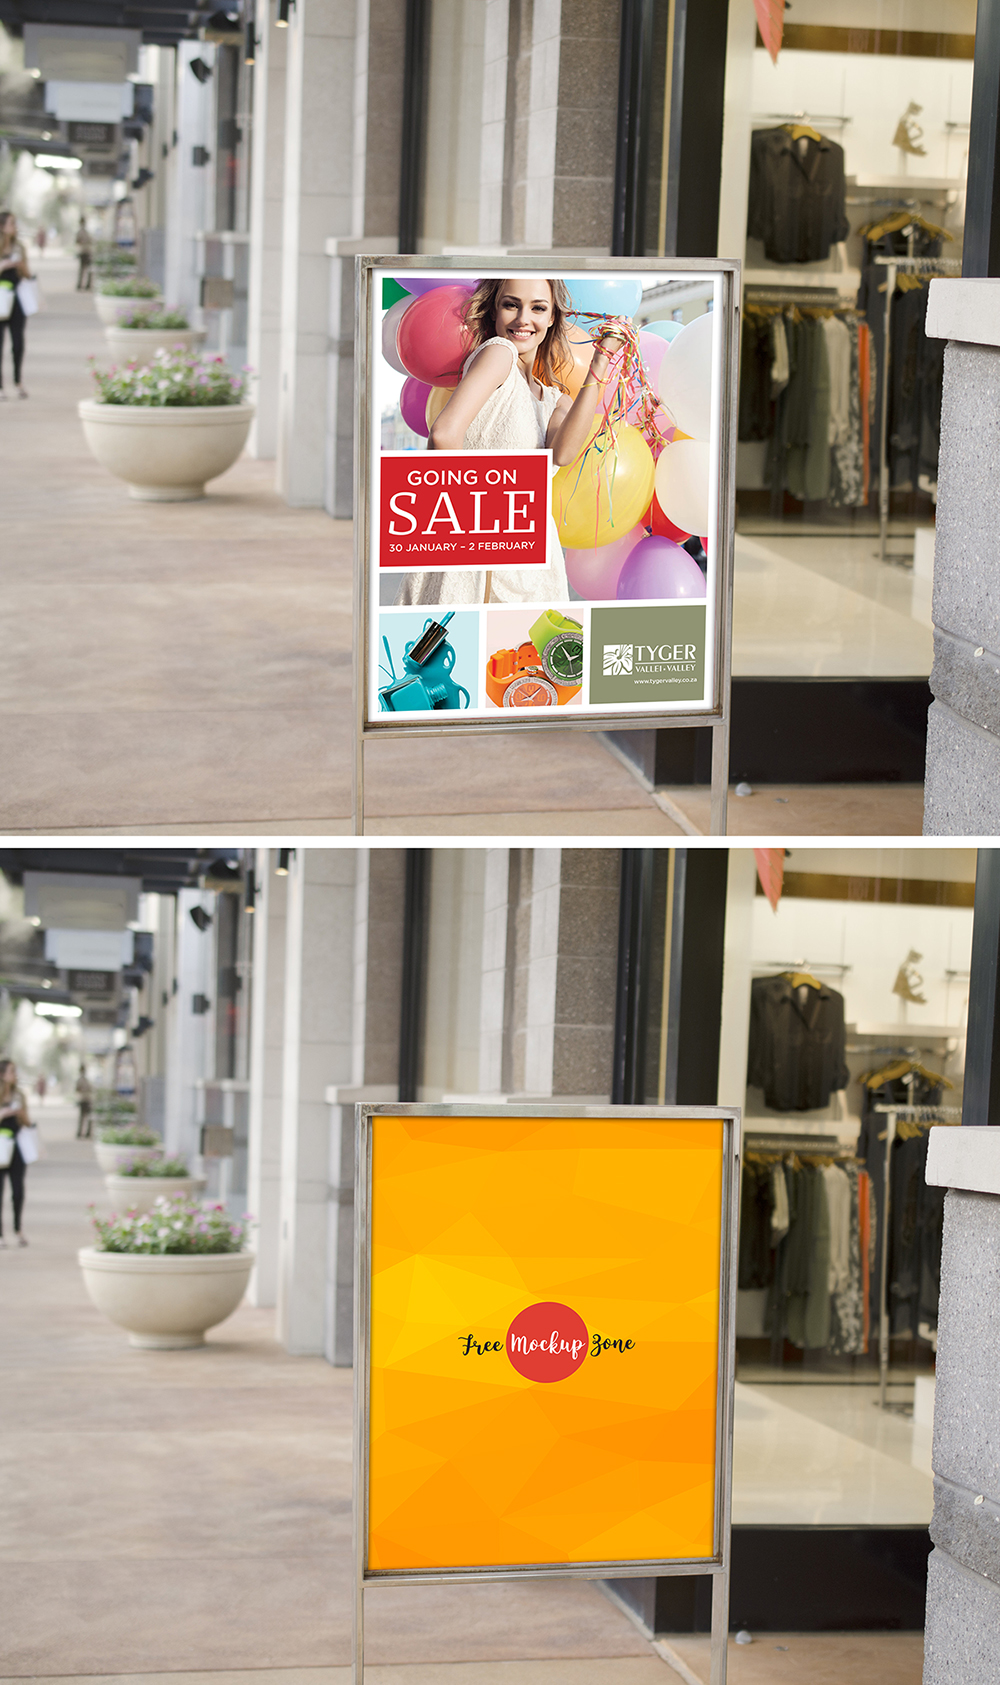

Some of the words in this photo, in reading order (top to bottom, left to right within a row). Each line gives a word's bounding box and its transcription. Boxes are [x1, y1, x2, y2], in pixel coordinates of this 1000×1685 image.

[407, 470, 478, 486] GOING
[485, 469, 517, 485] ON
[388, 490, 535, 536] SALE
[389, 543, 403, 553] 30
[406, 542, 457, 552] JANUARY
[468, 542, 475, 551] 2
[478, 541, 535, 551] FEBRUARY
[634, 644, 696, 661] TYGER
[633, 677, 698, 685] www.tygervalley.co.za
[458, 1333, 504, 1356] Free
[511, 1330, 586, 1360] Mockup
[590, 1333, 636, 1357] Zone
